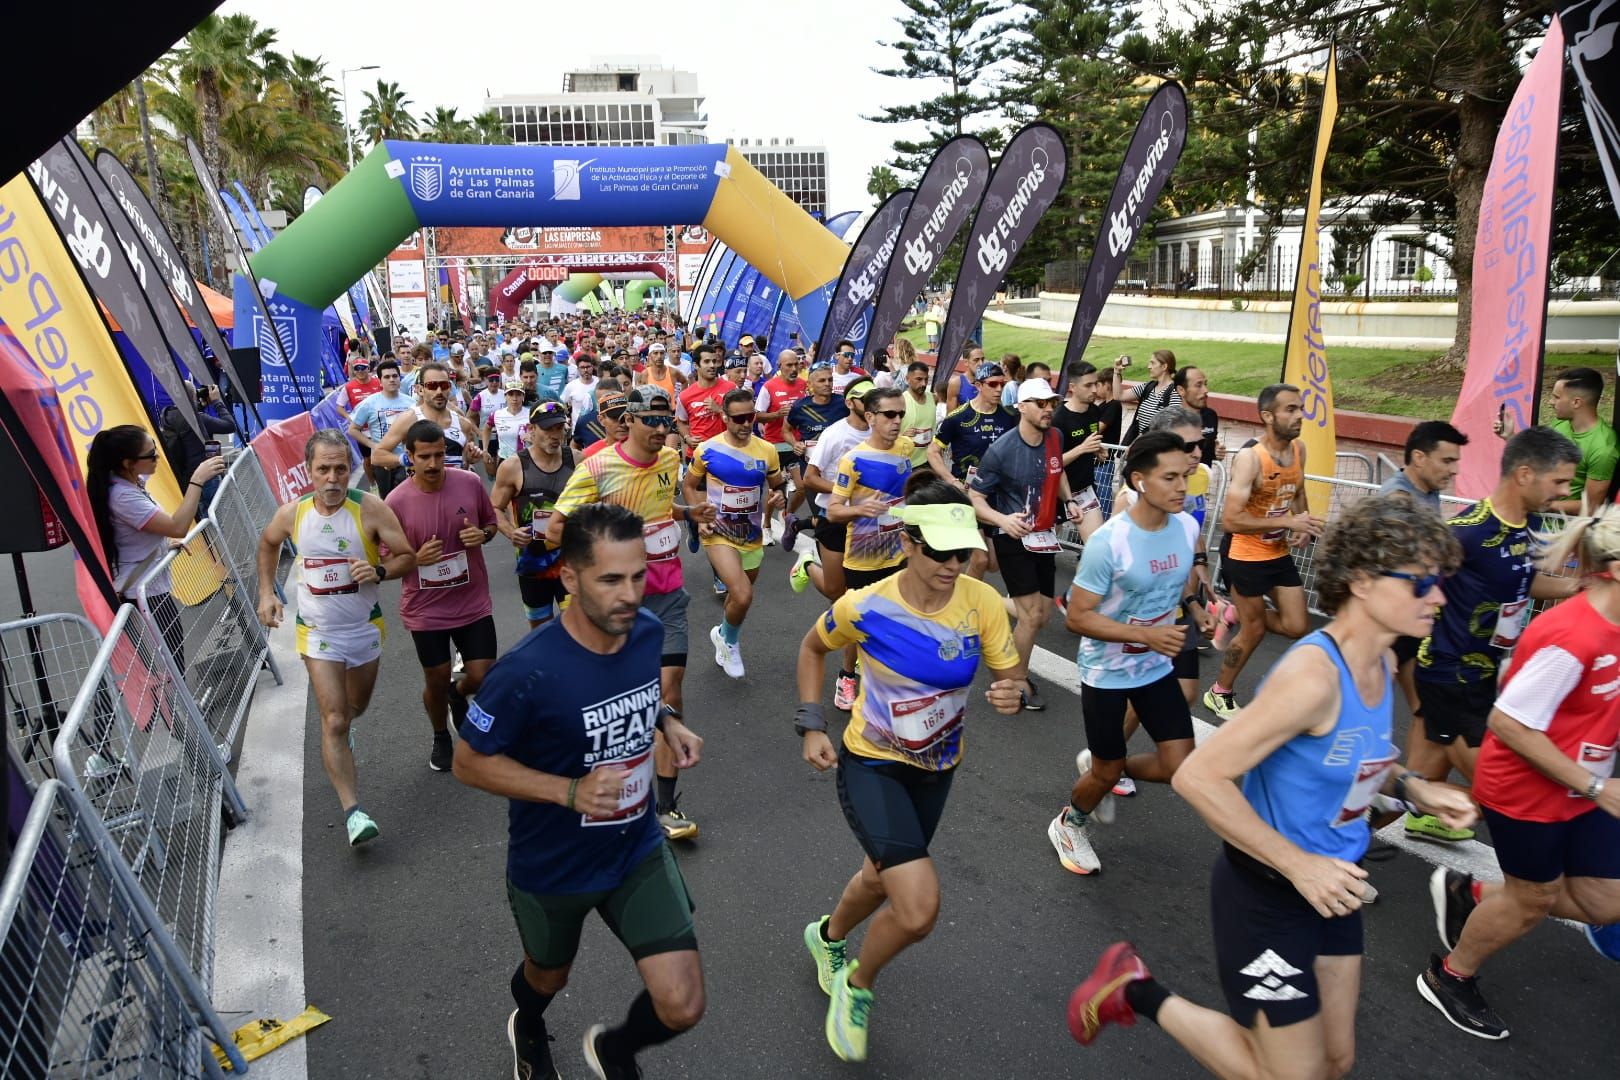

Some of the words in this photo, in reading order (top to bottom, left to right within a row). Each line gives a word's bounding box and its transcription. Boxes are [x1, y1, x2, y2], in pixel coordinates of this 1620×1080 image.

[449, 165, 534, 177] Ayuntamiento
[617, 165, 649, 174] Municipal
[673, 164, 708, 172] Promoción
[1128, 129, 1169, 216] EVENTOS
[449, 177, 464, 187] de
[470, 177, 489, 187] Las
[495, 177, 535, 187] Palmas
[608, 173, 639, 181] Actividad
[671, 173, 697, 181] Deporte
[600, 184, 612, 192] Las
[613, 183, 639, 192] Palmas
[640, 183, 650, 191] de
[651, 183, 670, 191] Gran
[671, 182, 699, 191] Canaria
[450, 188, 464, 198] de
[466, 189, 492, 198] Gran
[495, 188, 535, 198] Canaria
[923, 170, 969, 243] EVENTOS
[997, 162, 1045, 240] EVENTOS
[544, 231, 560, 242] LAS
[560, 231, 602, 242] EMPRESAS
[1149, 553, 1180, 574] Bull
[324, 572, 339, 582] 452
[437, 567, 451, 577] 330
[582, 683, 661, 731] RUNNING
[922, 708, 945, 731] 1678
[585, 700, 661, 752] TEAM
